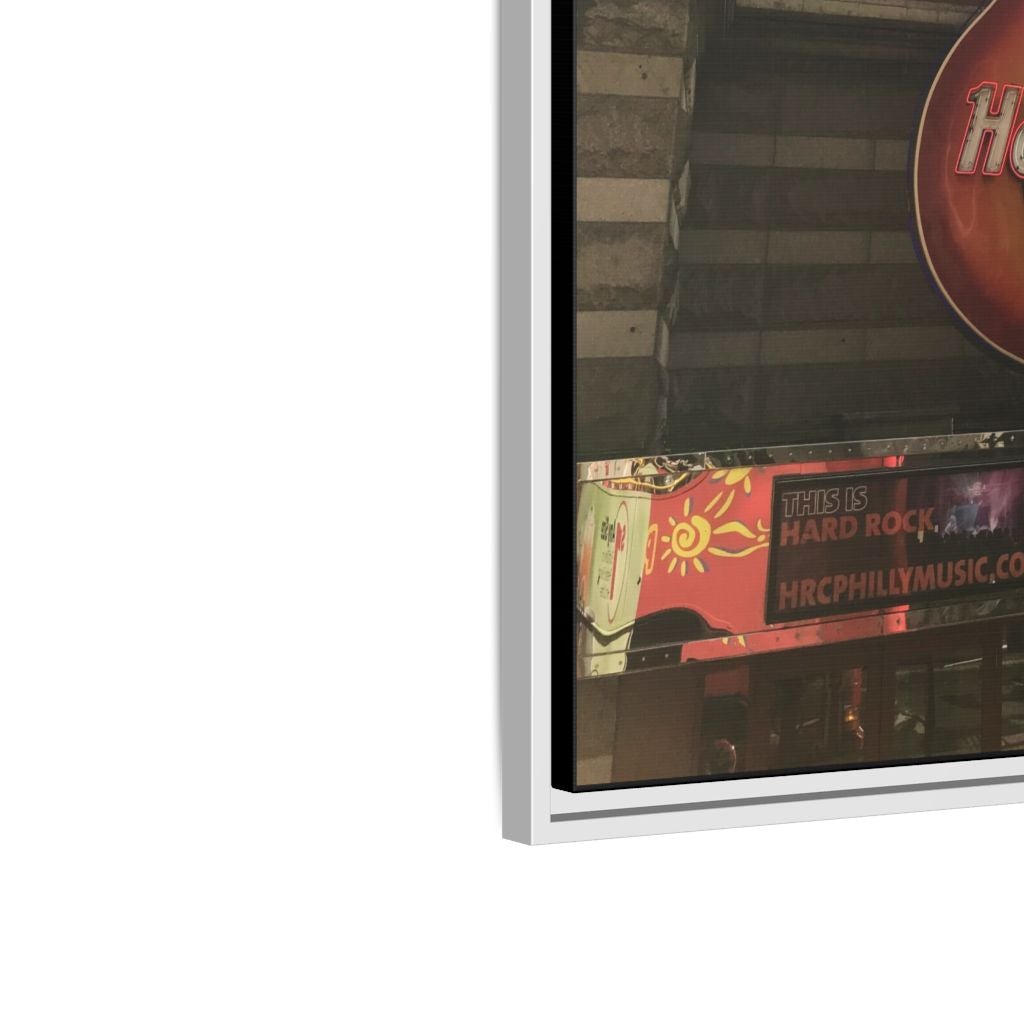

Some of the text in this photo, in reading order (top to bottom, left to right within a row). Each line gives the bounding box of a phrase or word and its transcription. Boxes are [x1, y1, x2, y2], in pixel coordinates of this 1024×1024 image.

[782, 485, 868, 517] THIS IS
[780, 516, 858, 546] HARD
